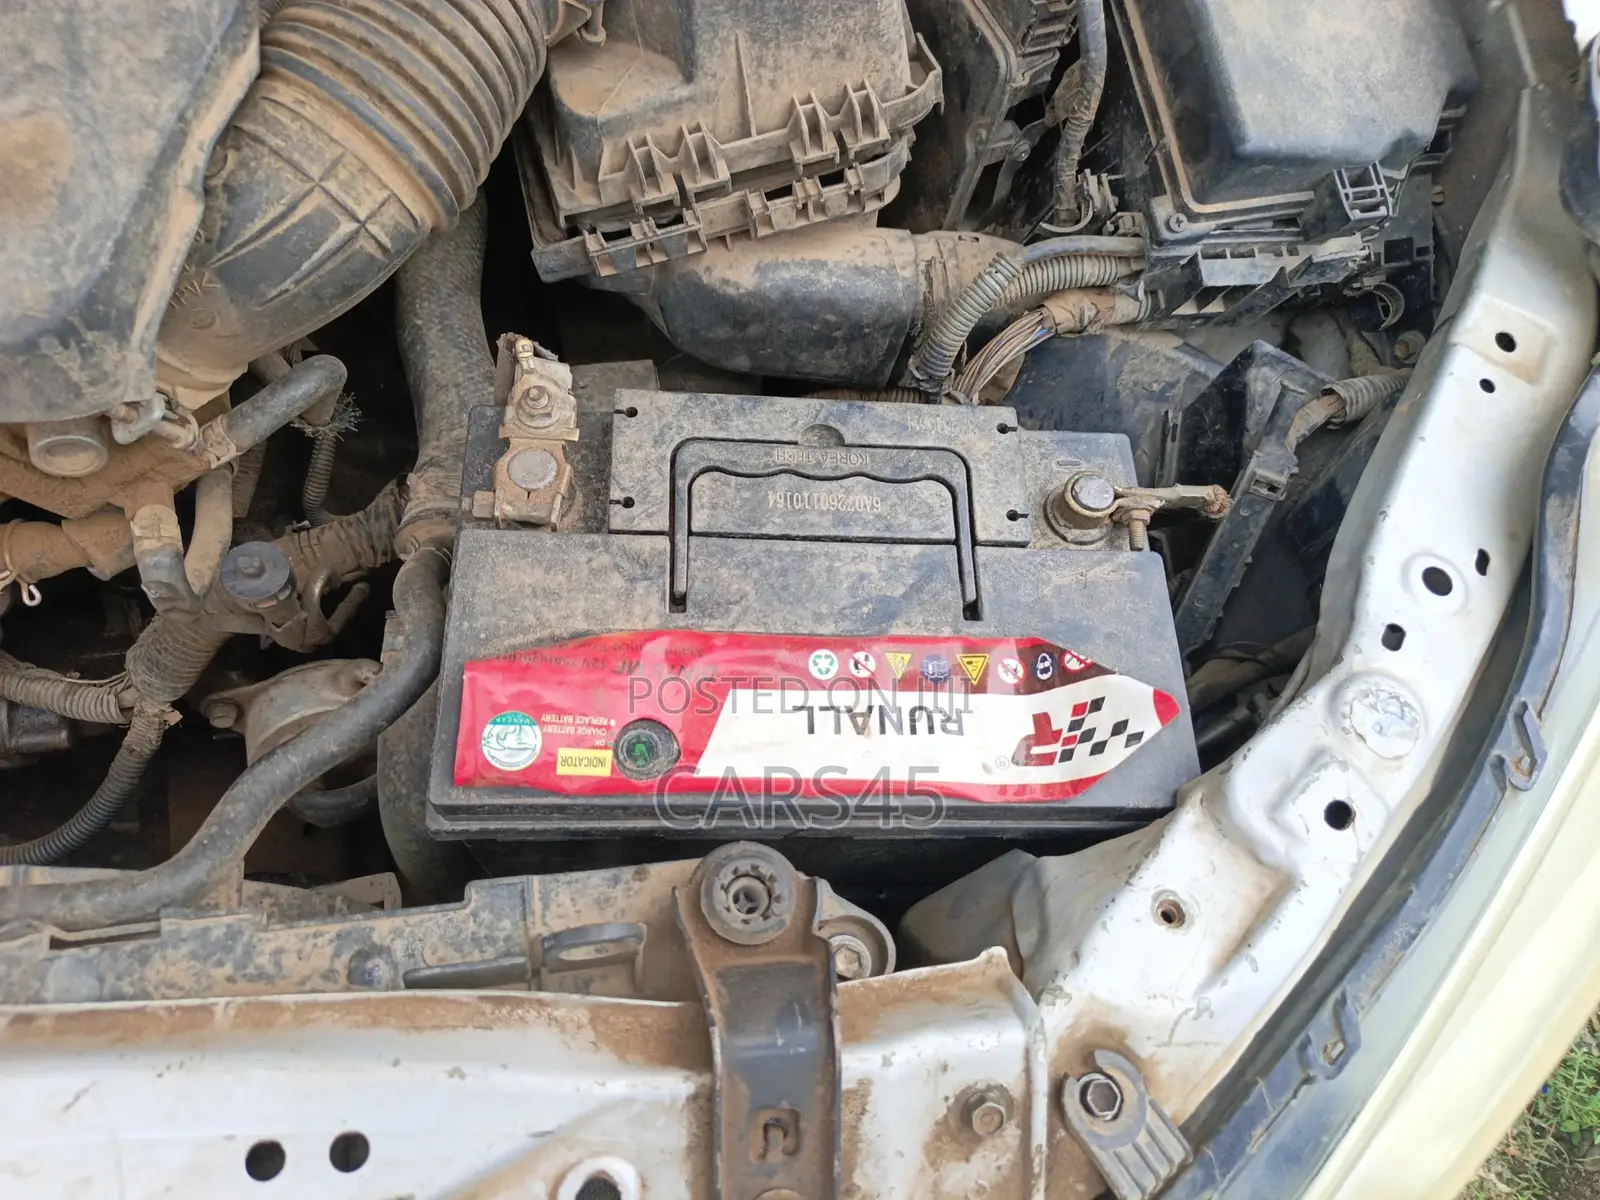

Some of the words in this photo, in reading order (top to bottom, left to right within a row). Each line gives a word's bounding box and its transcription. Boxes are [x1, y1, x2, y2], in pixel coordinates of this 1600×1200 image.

[821, 453, 870, 466] KOREA
[541, 713, 574, 723] BATTERY
[574, 715, 608, 726] REPLACE
[792, 704, 965, 737] RUNALL
[542, 725, 576, 736] BATTERY
[576, 726, 607, 736] CHARGE
[594, 739, 606, 747] OK
[559, 755, 607, 768] INDICATOR
